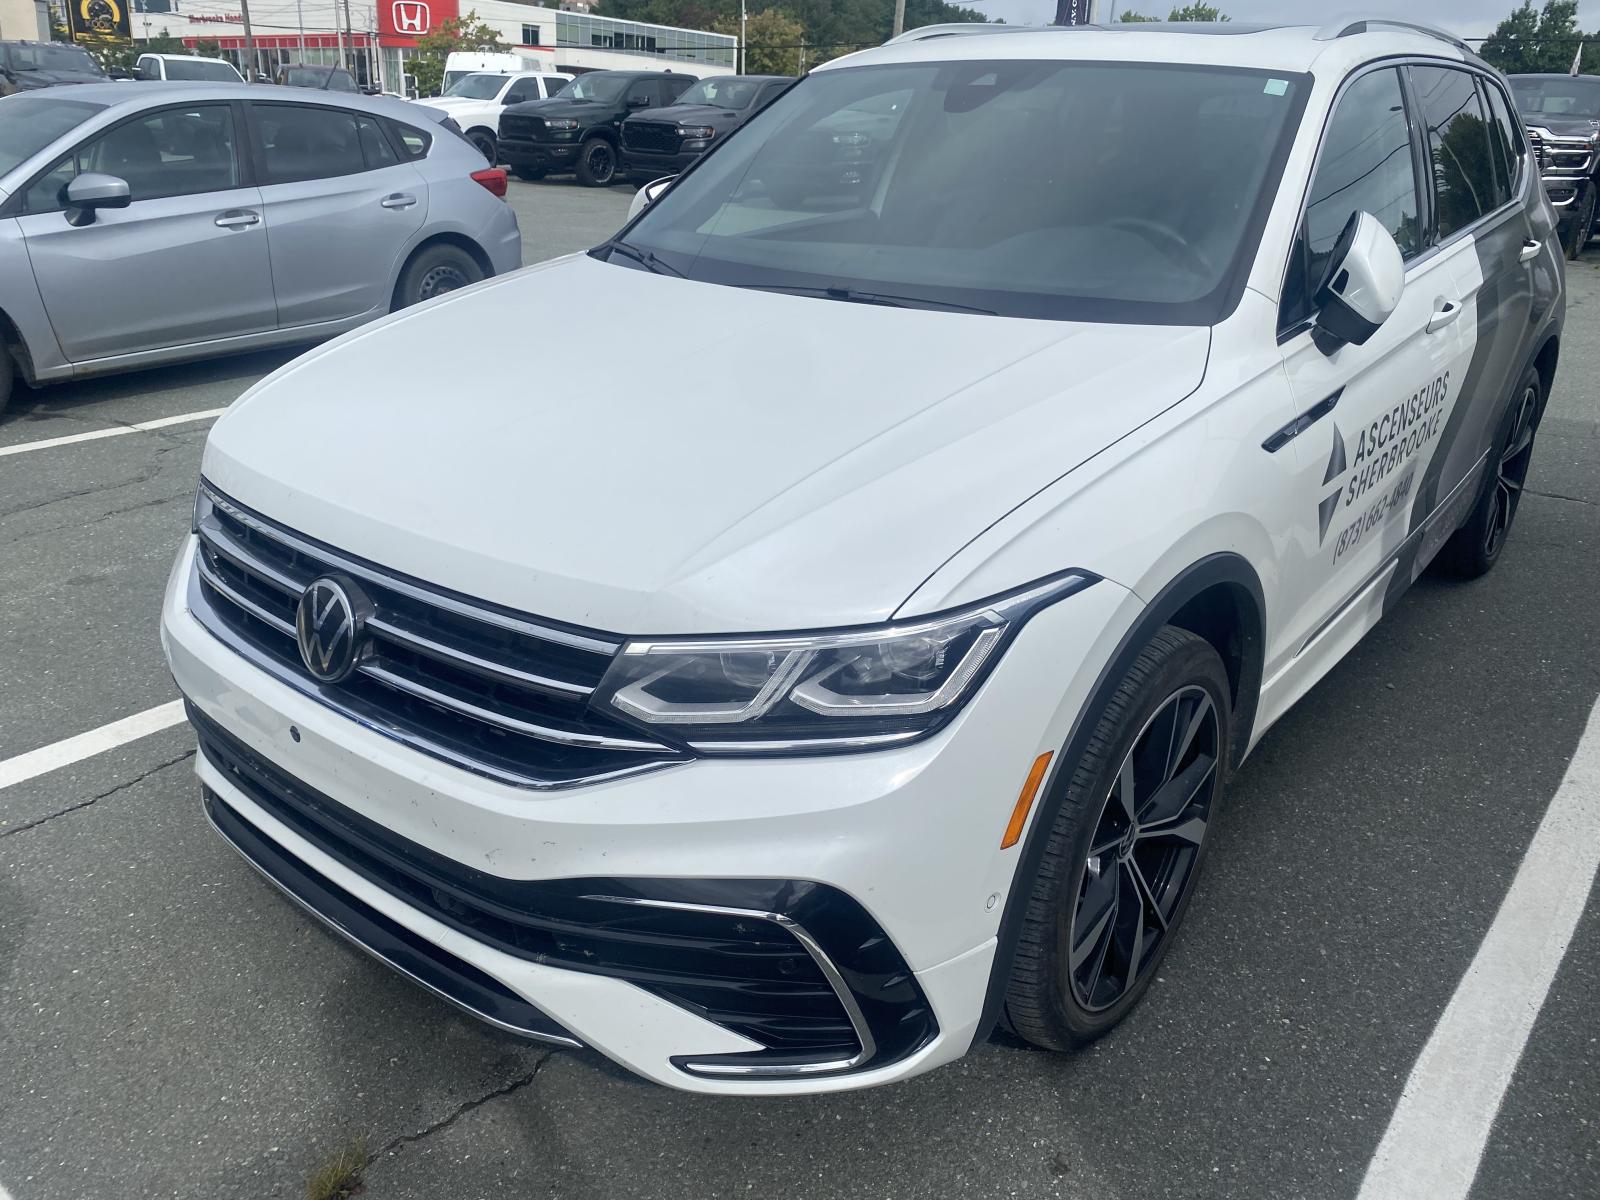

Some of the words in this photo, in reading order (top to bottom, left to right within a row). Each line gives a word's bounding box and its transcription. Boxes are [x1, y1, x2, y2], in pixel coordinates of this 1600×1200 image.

[1345, 407, 1443, 507] SHERBROOKE
[1353, 370, 1450, 468] ASCENSEURS
[1332, 511, 1367, 566] (873)
